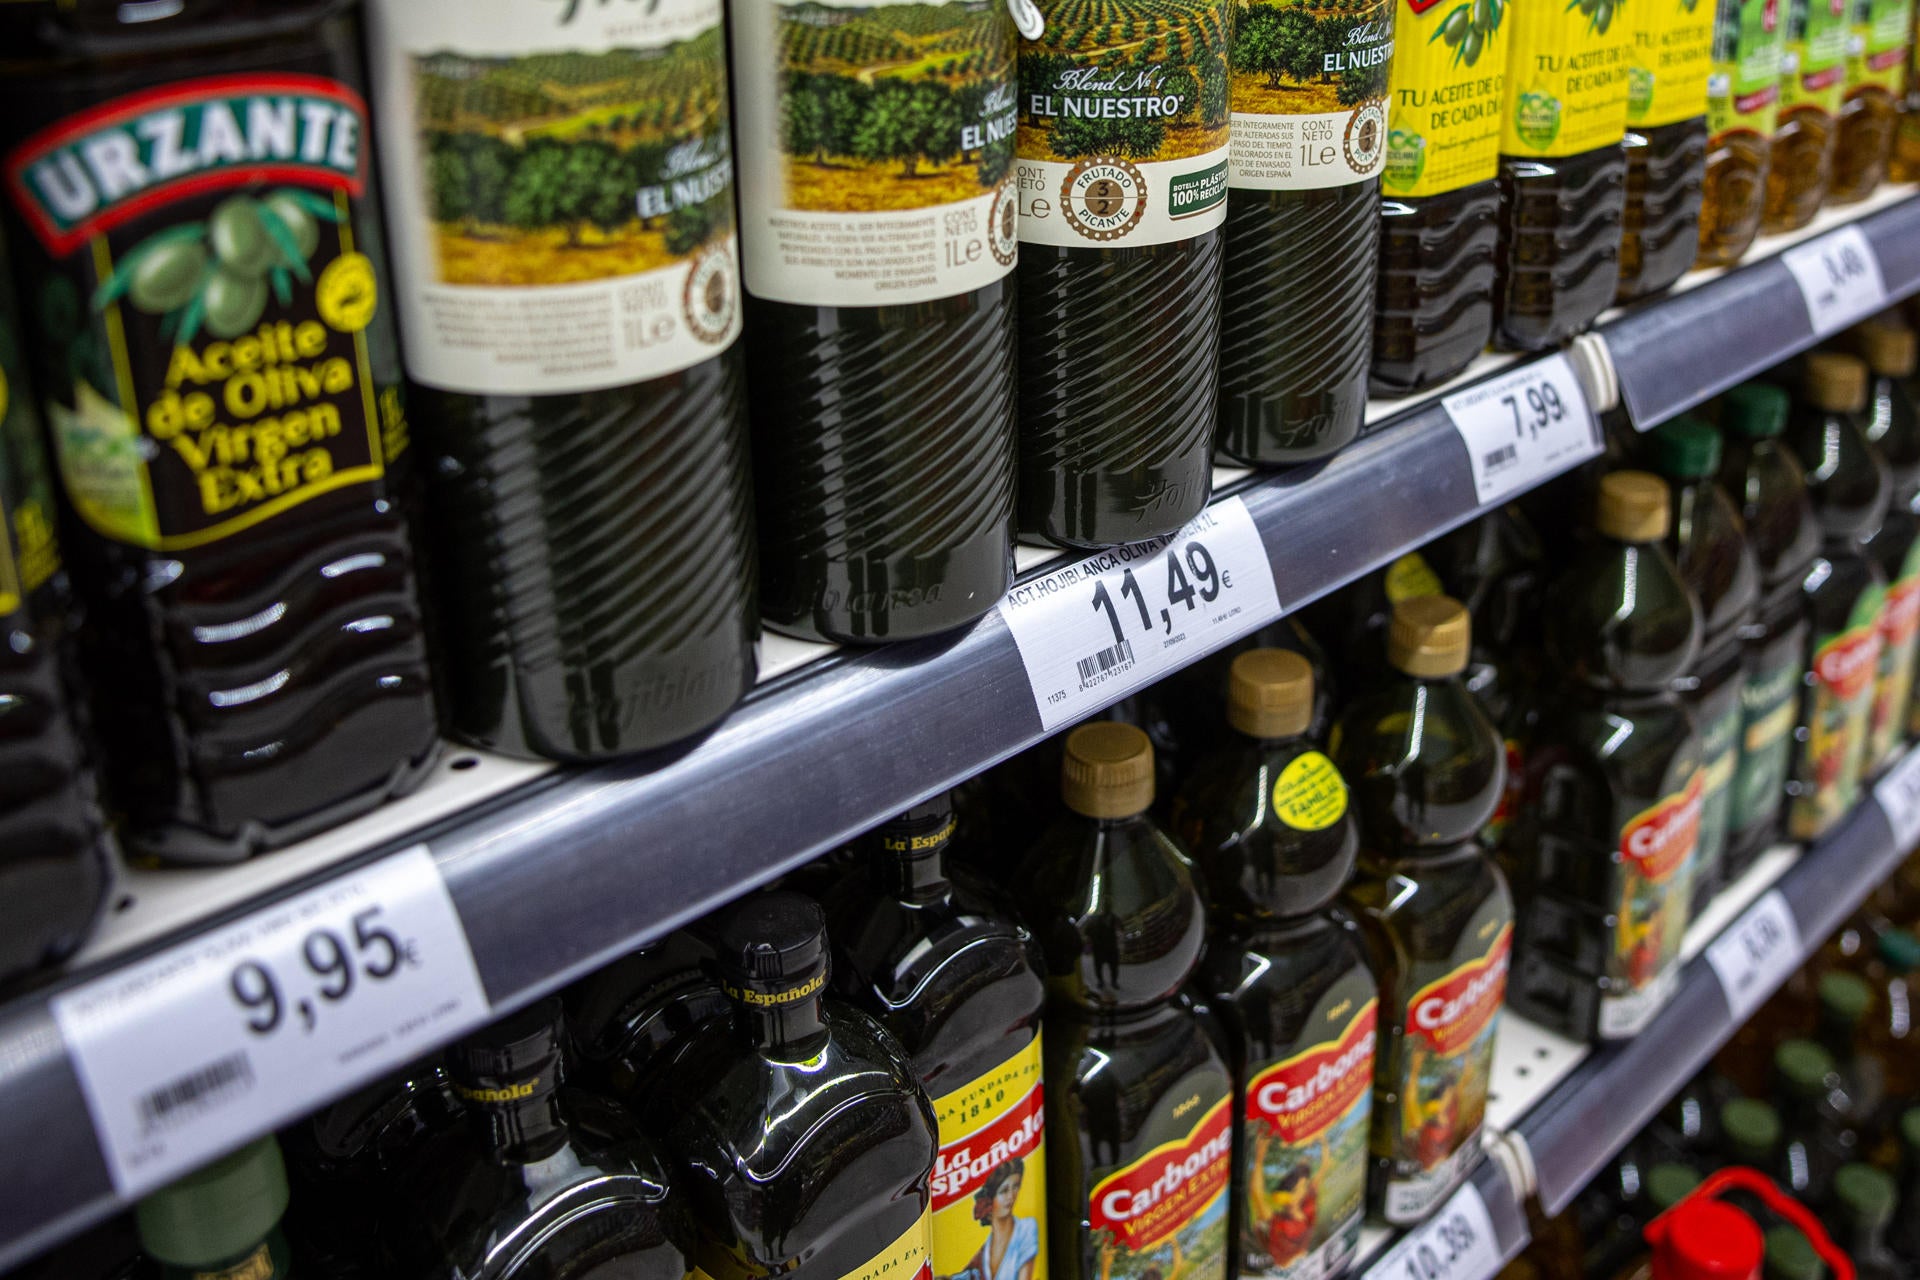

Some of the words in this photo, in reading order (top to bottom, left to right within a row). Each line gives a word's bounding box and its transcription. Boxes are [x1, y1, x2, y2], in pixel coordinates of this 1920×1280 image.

[1323, 54, 1345, 72] EL
[1536, 54, 1562, 72] TU
[1053, 66, 1120, 92] Blend
[1397, 89, 1426, 107] TU
[1431, 81, 1475, 105] ACEITE
[1477, 77, 1493, 97] DE
[1031, 94, 1058, 116] EL
[1431, 112, 1449, 130] DE
[1451, 103, 1484, 125] CADA
[961, 124, 986, 151] EL
[1302, 130, 1333, 141] NETO
[34, 97, 358, 221] URZANTE
[1076, 167, 1132, 189] FRUTADO
[1173, 181, 1200, 192] BOTELLA
[1240, 169, 1264, 177] ORIGEN
[1266, 169, 1292, 178] ESPAÑA
[636, 186, 673, 219] EL
[1097, 181, 1109, 198] 3
[1172, 189, 1200, 207] 100%
[1078, 208, 1130, 228] PICANTE
[1097, 199, 1109, 215] 2
[165, 319, 328, 389] Aceite
[147, 389, 215, 440] de
[223, 357, 354, 418] Oliva
[171, 402, 342, 472] Virgen
[200, 447, 333, 515] Extra
[1007, 553, 1121, 610] ACT.HOJIBLANCA
[1120, 540, 1164, 562] OLIVA
[1047, 689, 1067, 704] 11375
[884, 837, 906, 851] La
[961, 1070, 1019, 1107] FUNDADA
[960, 1089, 1006, 1125] 1840
[933, 1147, 971, 1179] La
